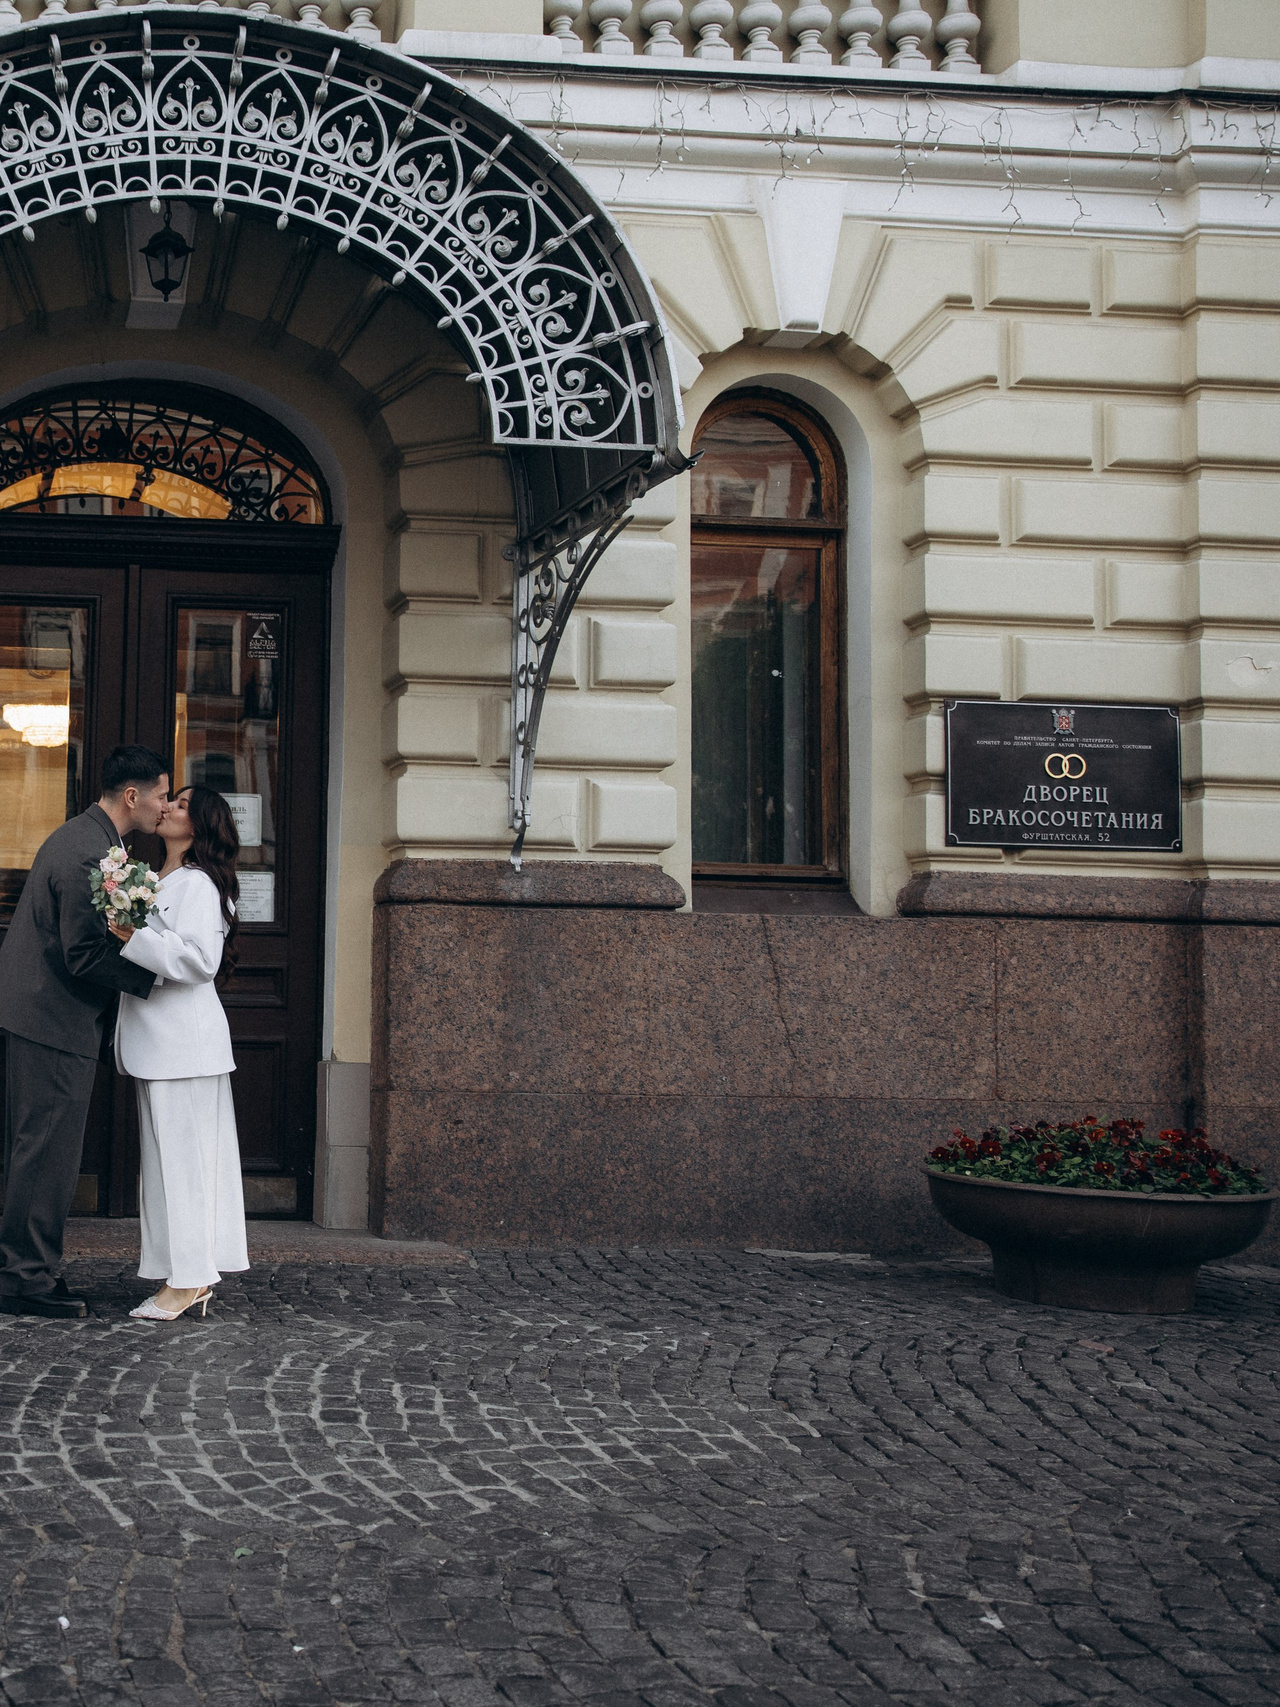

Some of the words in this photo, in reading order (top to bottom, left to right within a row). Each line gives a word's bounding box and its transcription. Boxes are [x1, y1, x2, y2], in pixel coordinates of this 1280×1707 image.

[1022, 785, 1110, 805] ДВОРЕЦ
[968, 808, 1163, 830] БРАКОСОЧЕТАНИЯ
[1097, 832, 1111, 842] 52
